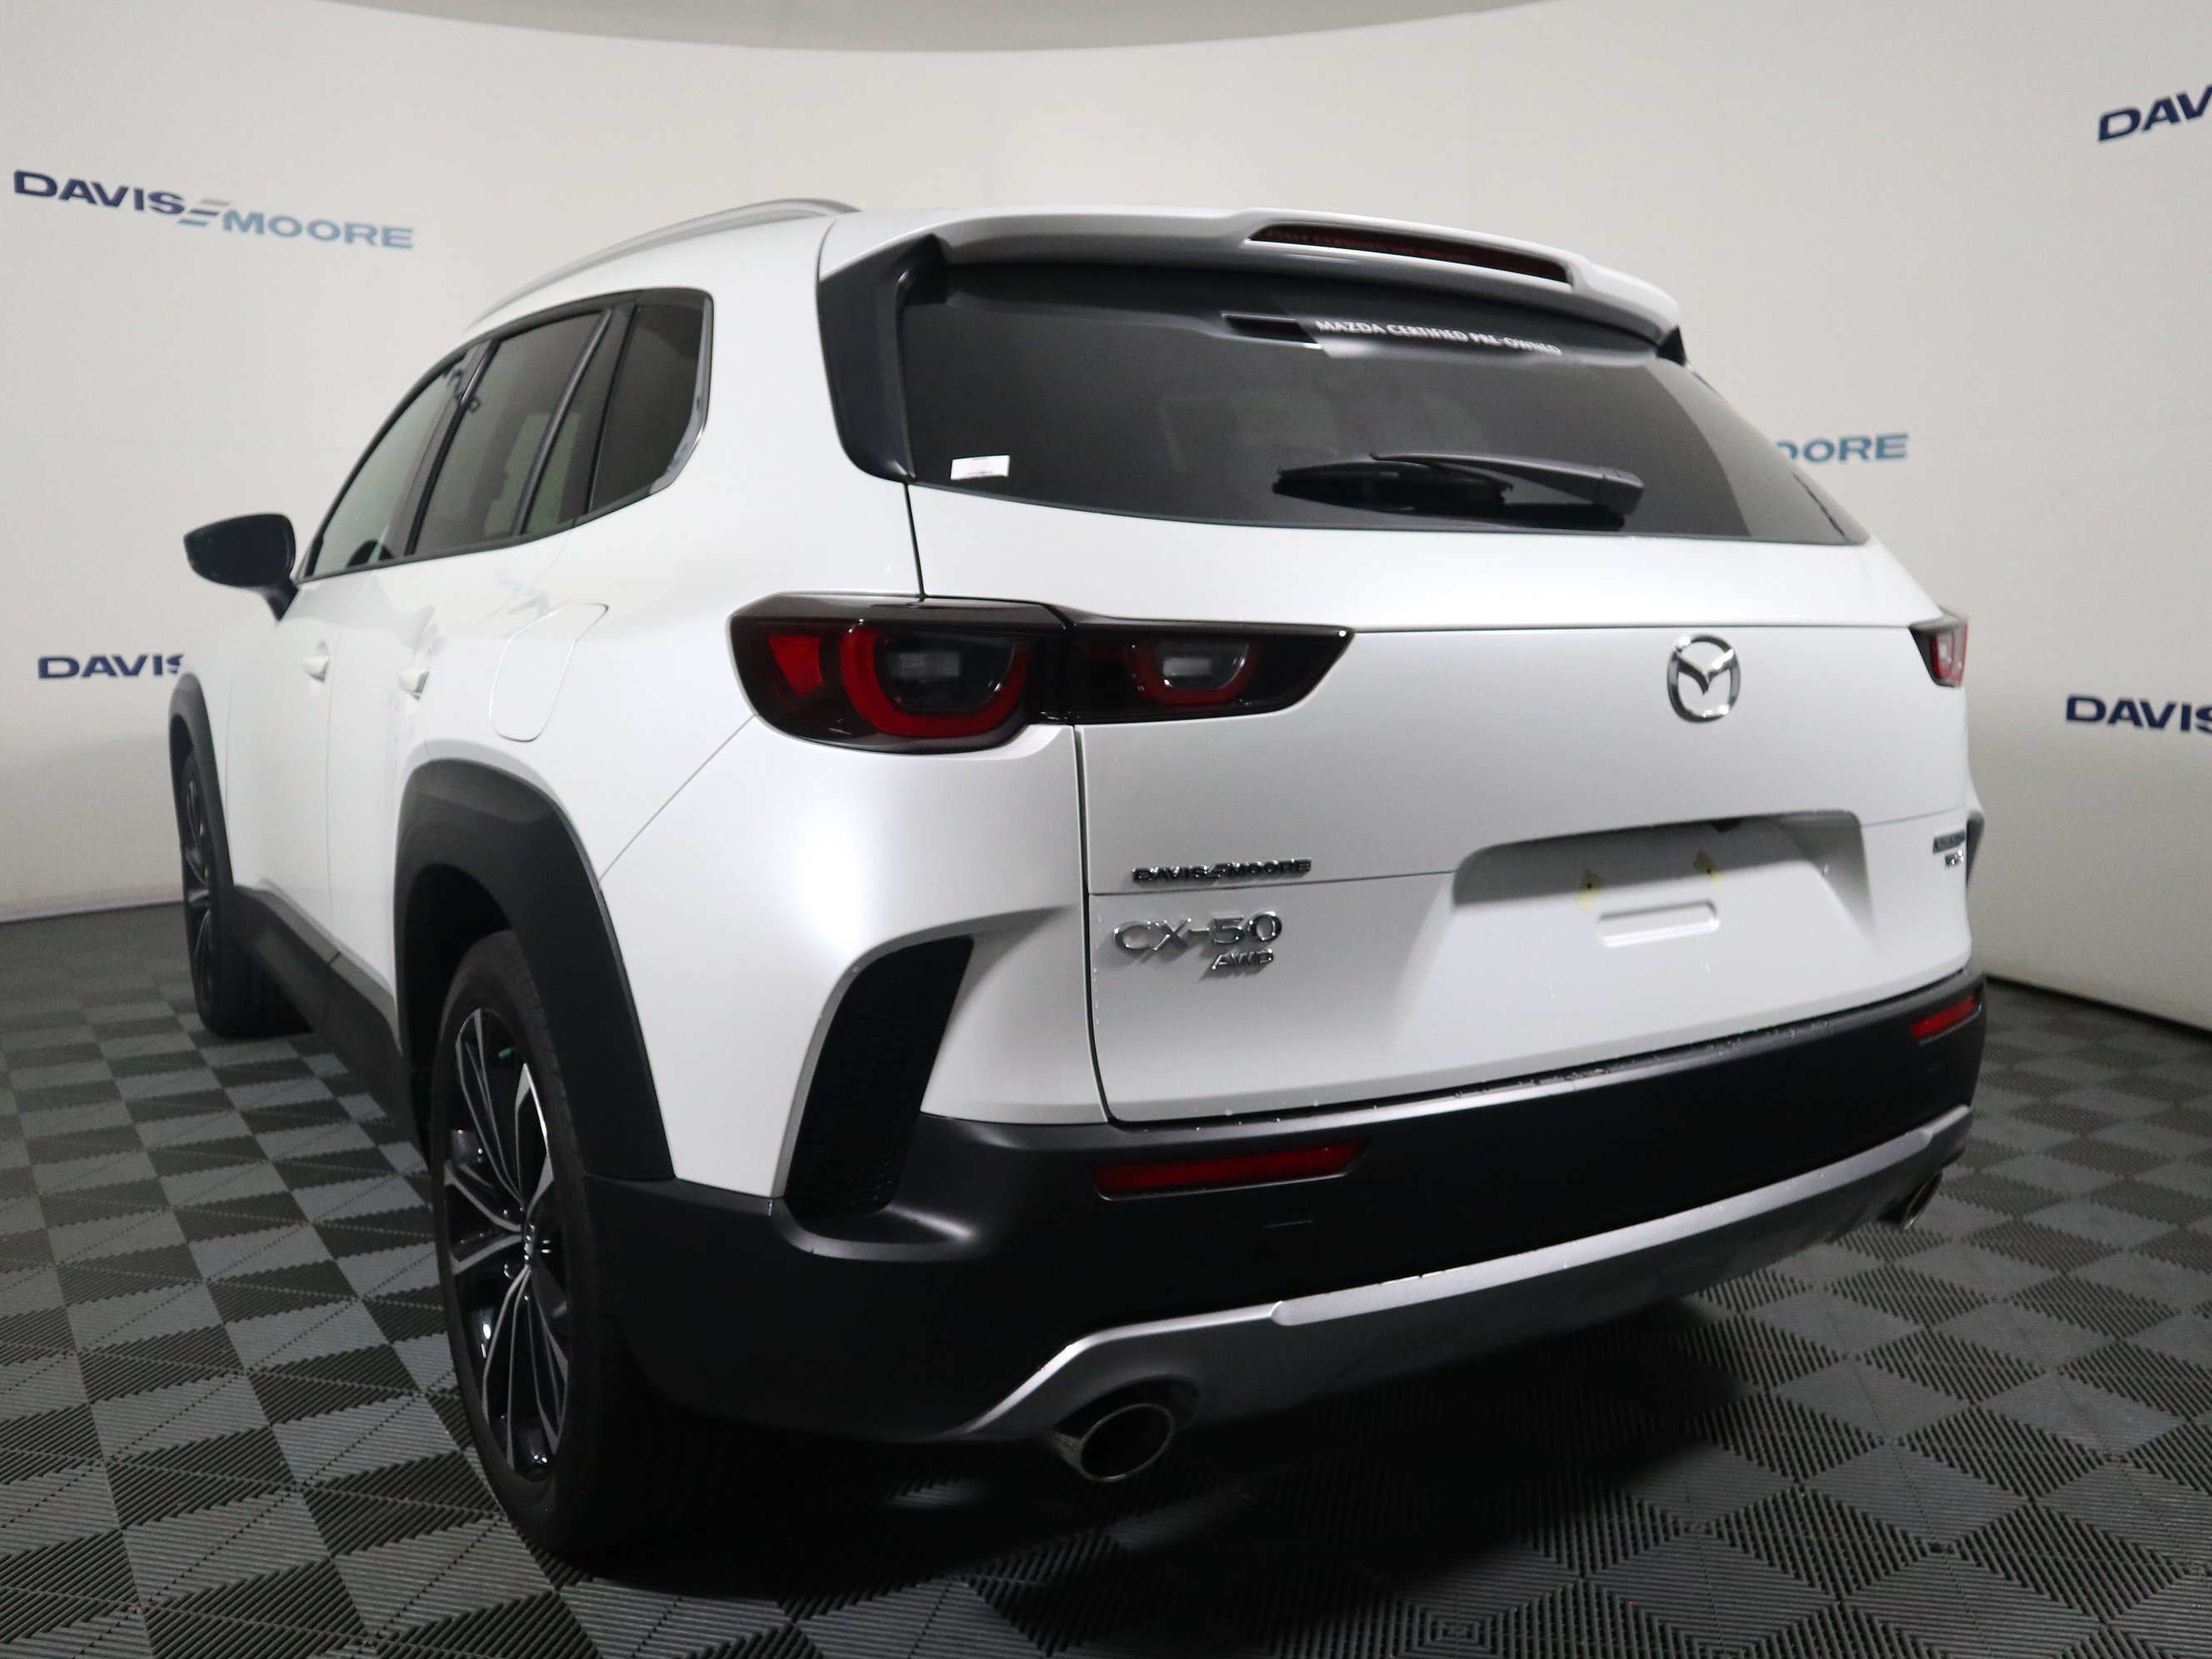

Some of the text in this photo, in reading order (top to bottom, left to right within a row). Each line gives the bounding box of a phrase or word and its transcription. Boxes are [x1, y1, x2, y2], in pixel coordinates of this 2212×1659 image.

[13, 170, 416, 249] DAVIS MOORE
[1315, 321, 1562, 356] MAZDA CERTIFIED PRE-OWNED
[1112, 910, 1283, 953] CX-50
[1210, 948, 1275, 970] AWD
